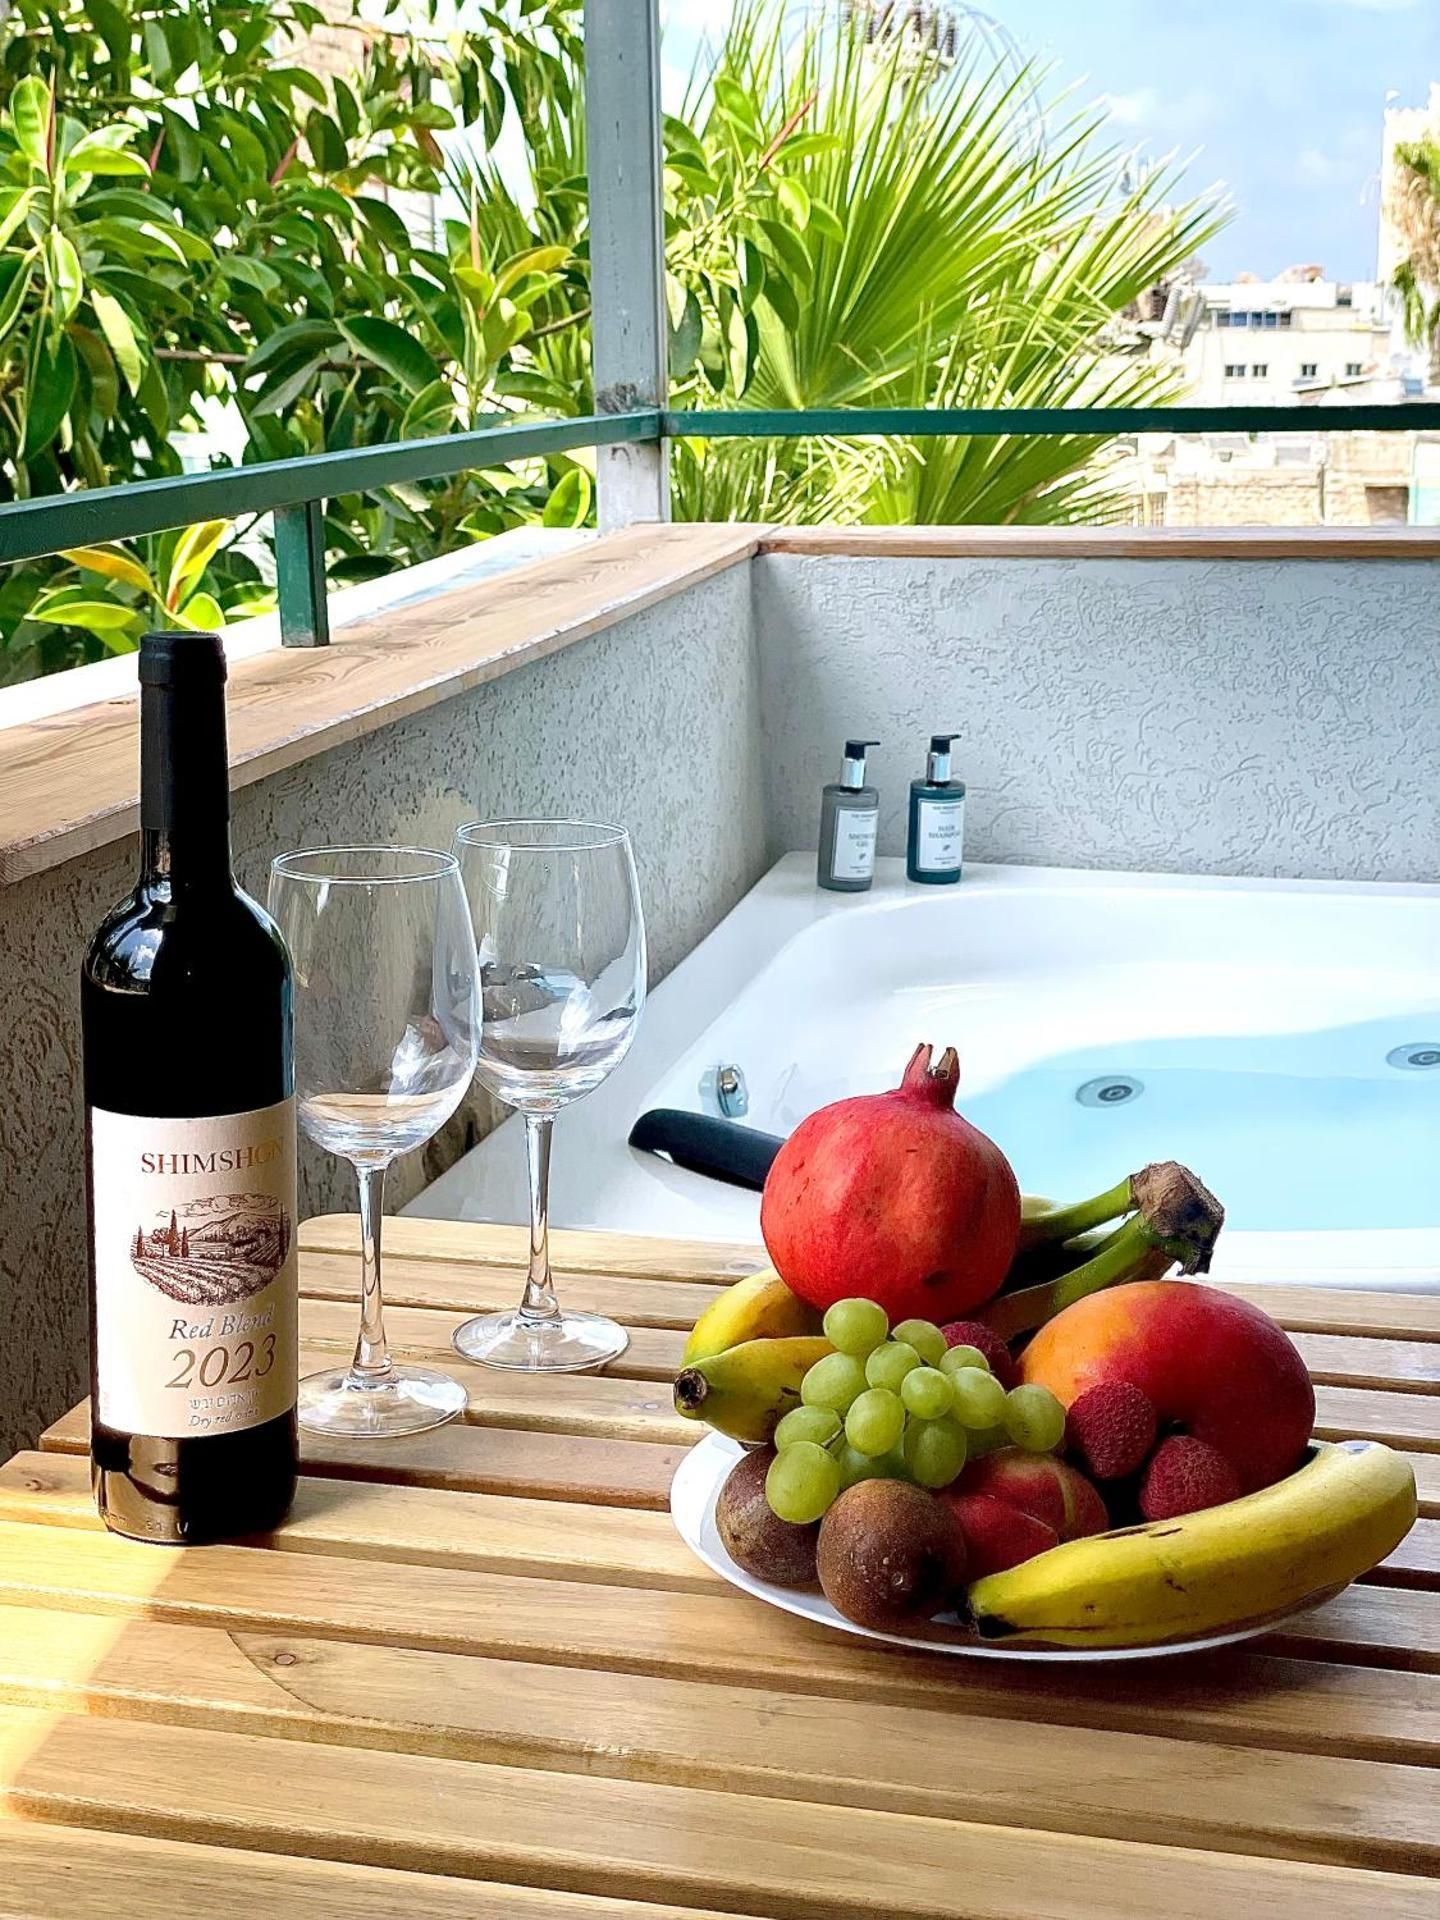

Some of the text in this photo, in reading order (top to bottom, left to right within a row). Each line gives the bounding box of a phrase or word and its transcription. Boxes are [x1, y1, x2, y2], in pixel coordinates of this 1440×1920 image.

[168, 1303, 276, 1340] Red Blend
[164, 1332, 277, 1389] 2023
[188, 1415, 212, 1429] Dry
